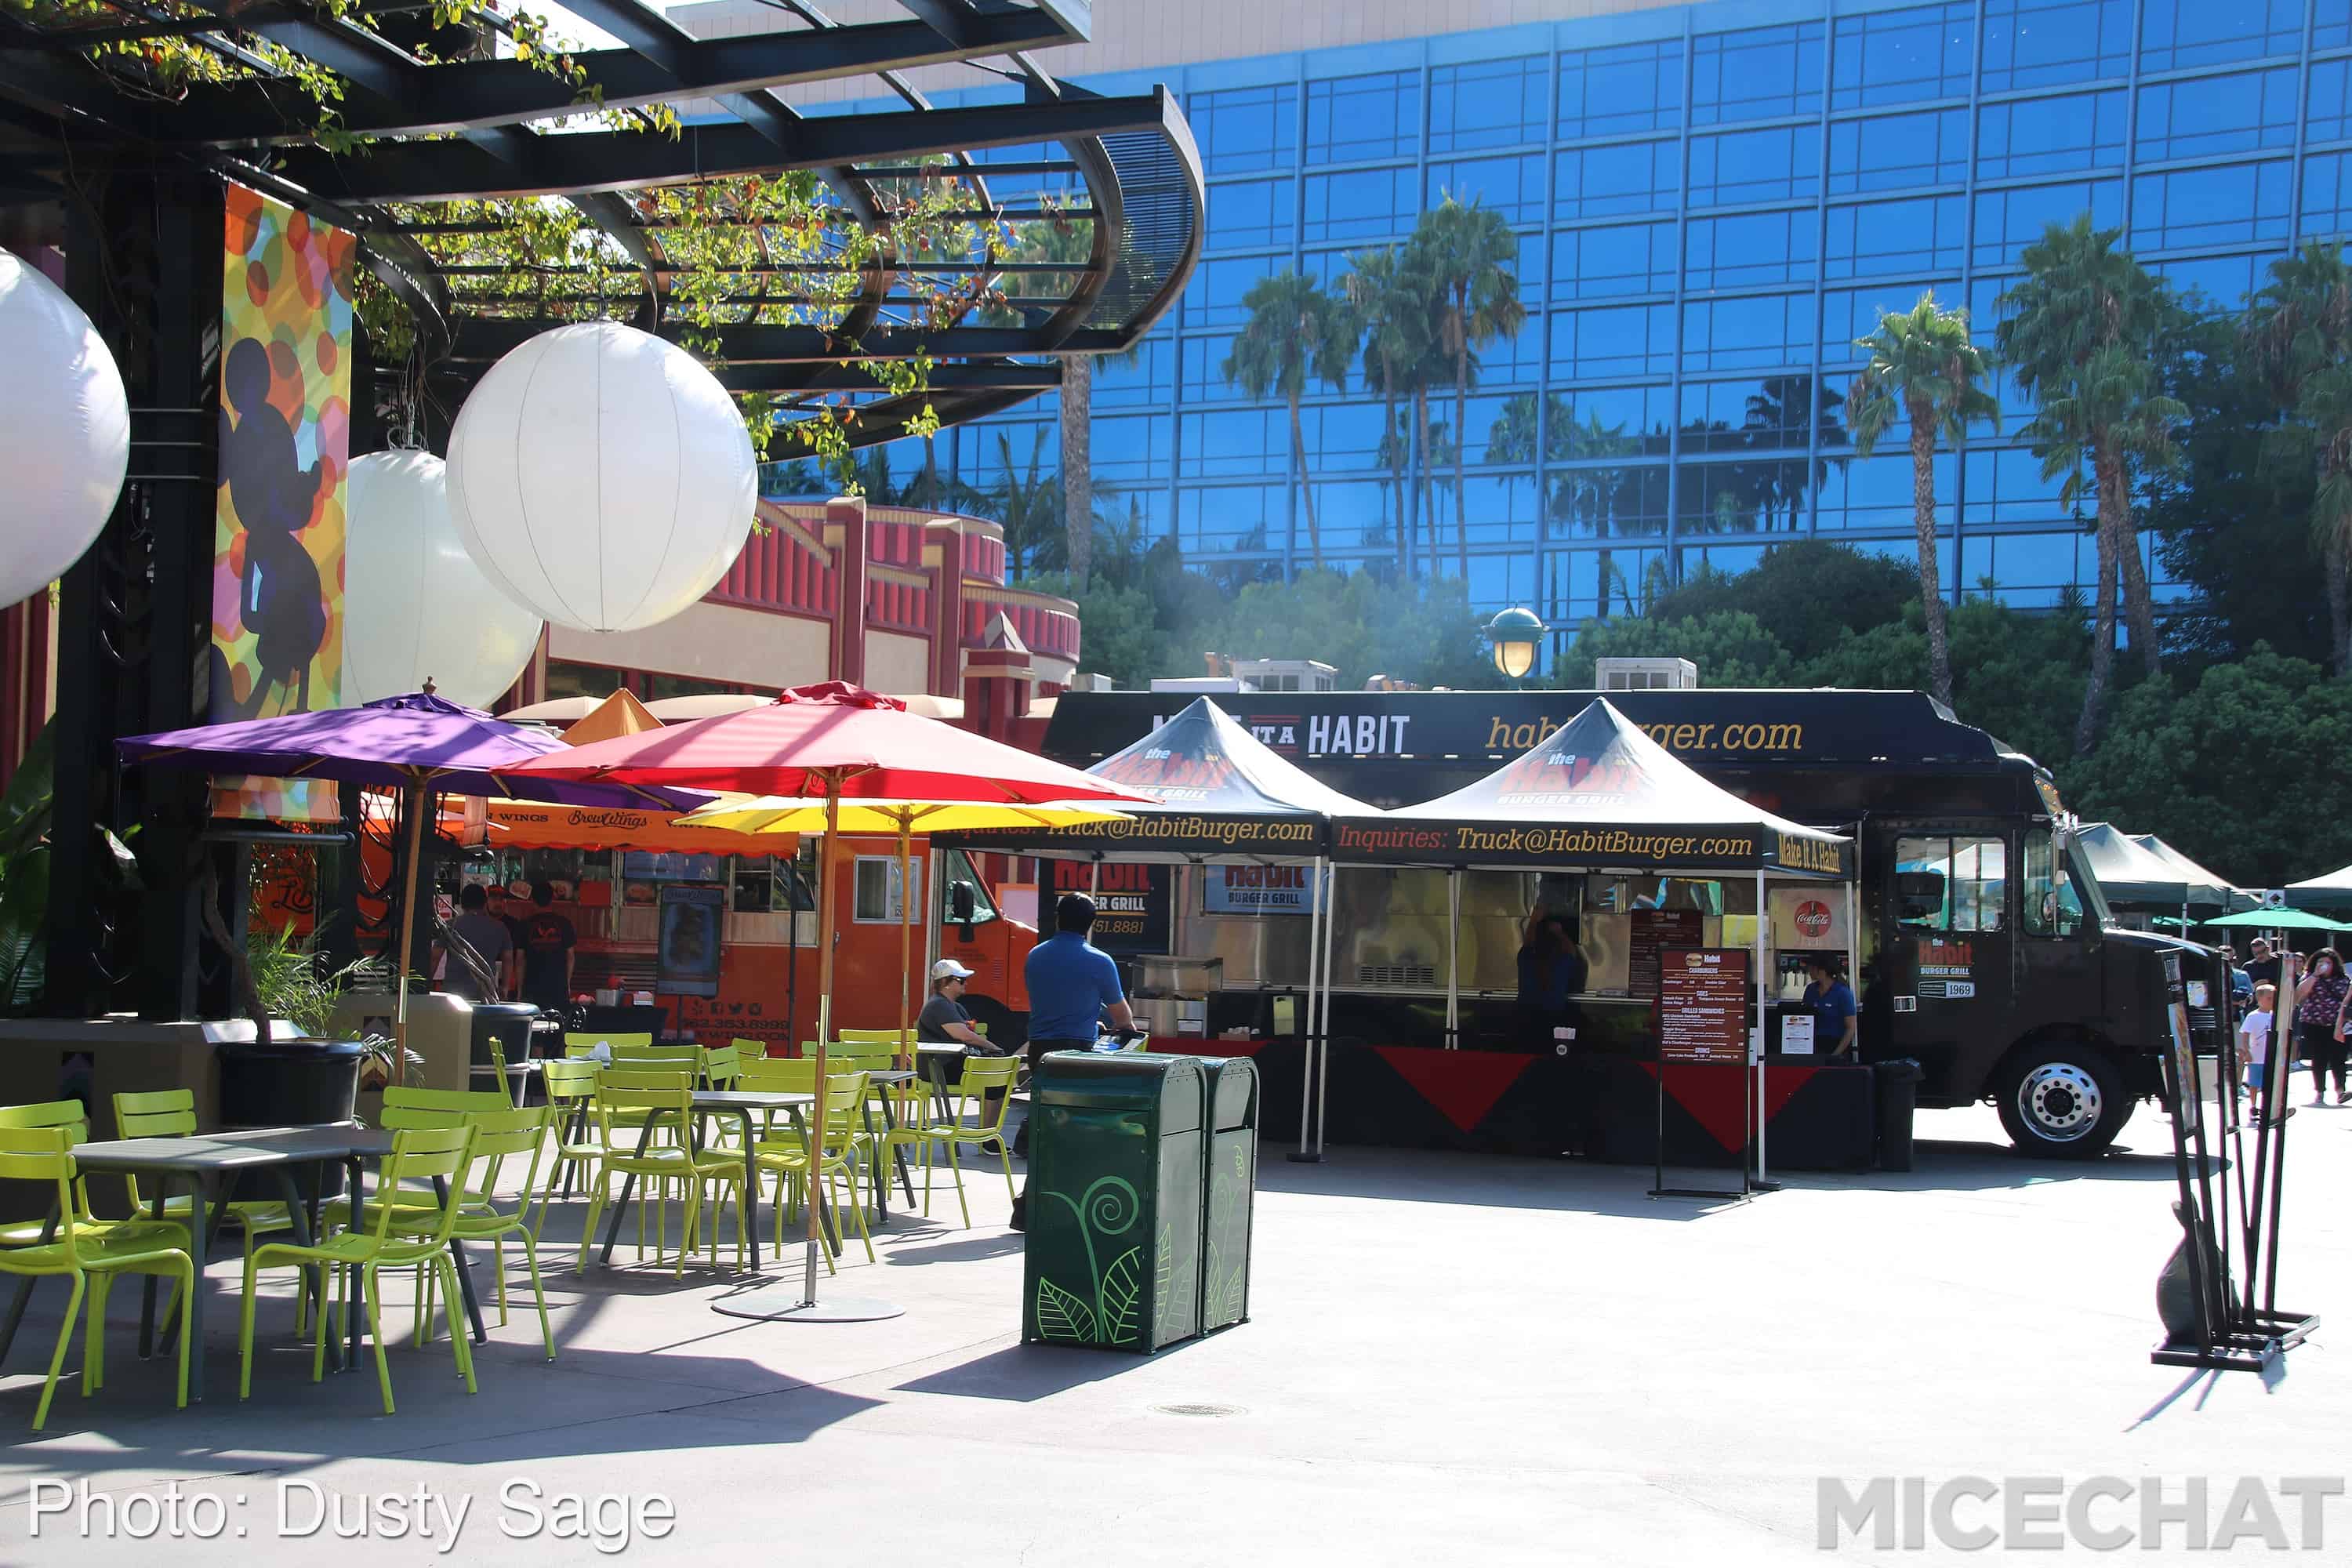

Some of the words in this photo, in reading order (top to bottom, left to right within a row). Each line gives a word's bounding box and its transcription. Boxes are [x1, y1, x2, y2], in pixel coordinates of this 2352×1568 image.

[1251, 726, 1276, 744] IT
[1279, 726, 1295, 744] A
[1308, 715, 1410, 754] HABIT
[1145, 747, 1171, 760] the
[1548, 752, 1576, 765] the
[1161, 787, 1208, 799] GRILL
[499, 812, 549, 822] WINGS
[1338, 824, 1449, 852] Inquiries:
[1457, 827, 1752, 860] Truck@HabitBurger.com
[1778, 833, 1802, 866] Make
[1803, 839, 1810, 869] It
[1812, 840, 1819, 870] A
[1819, 842, 1841, 873] Habit
[1111, 897, 1145, 912] GRILL
[1229, 891, 1269, 904] BURGER
[1271, 893, 1300, 905] GRILL
[1950, 985, 1970, 995] 1969
